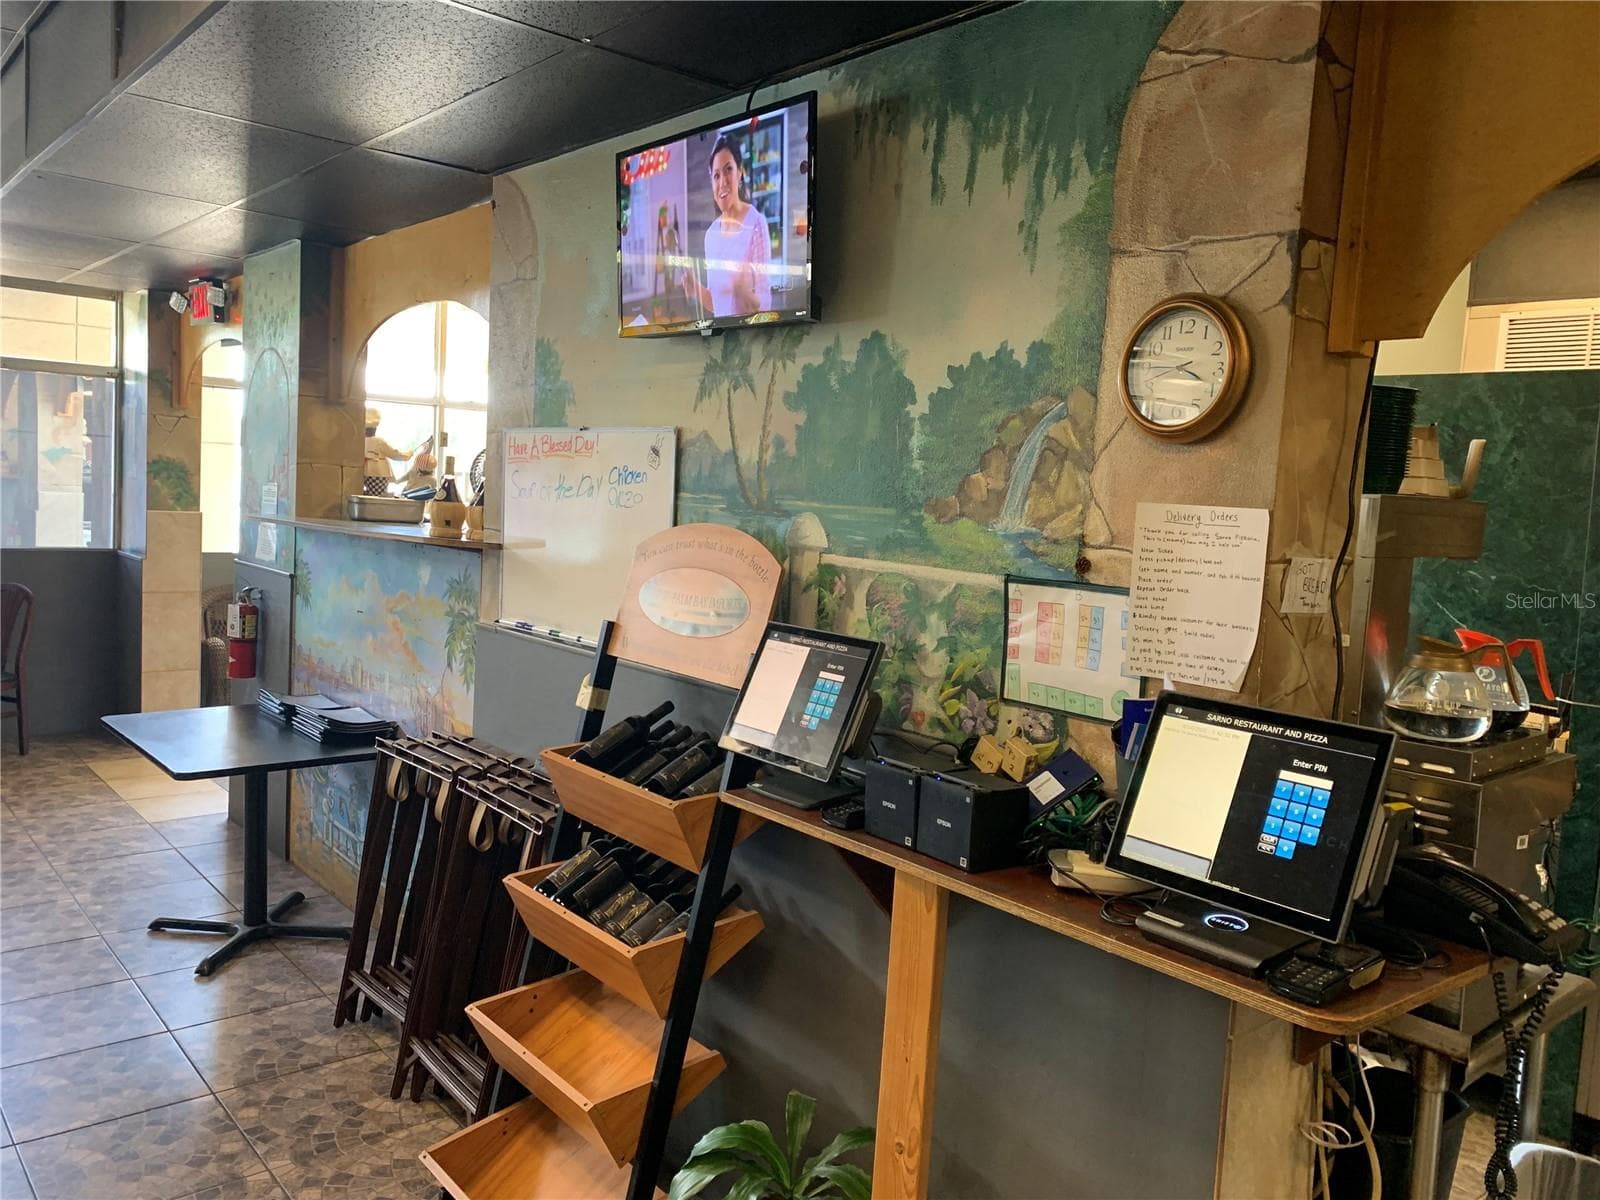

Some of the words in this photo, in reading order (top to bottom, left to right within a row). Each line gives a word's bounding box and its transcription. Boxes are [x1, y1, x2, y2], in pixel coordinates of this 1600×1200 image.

[1162, 325, 1172, 340] 11
[1178, 319, 1196, 334] 12
[1203, 325, 1209, 339] 1
[1149, 342, 1163, 356] 10
[1211, 341, 1223, 356] 2
[1212, 362, 1224, 377] 3
[508, 435, 529, 459] Have
[530, 434, 541, 458] A
[540, 435, 574, 456] Blessed
[608, 464, 648, 486] Chicken
[1166, 510, 1201, 528] Delivery
[1210, 511, 1240, 522] Orders
[675, 538, 696, 551] trust
[736, 547, 748, 564] the
[749, 556, 769, 584] bottle
[1206, 713, 1232, 725] SARNO
[1233, 719, 1284, 735] RESTAURANT
[1284, 729, 1302, 739] AND
[1303, 733, 1329, 745] PIZZA
[1292, 759, 1313, 770] Enter
[1313, 763, 1329, 773] PIN
[882, 800, 897, 810] EPSON
[936, 818, 952, 829] EPSON
